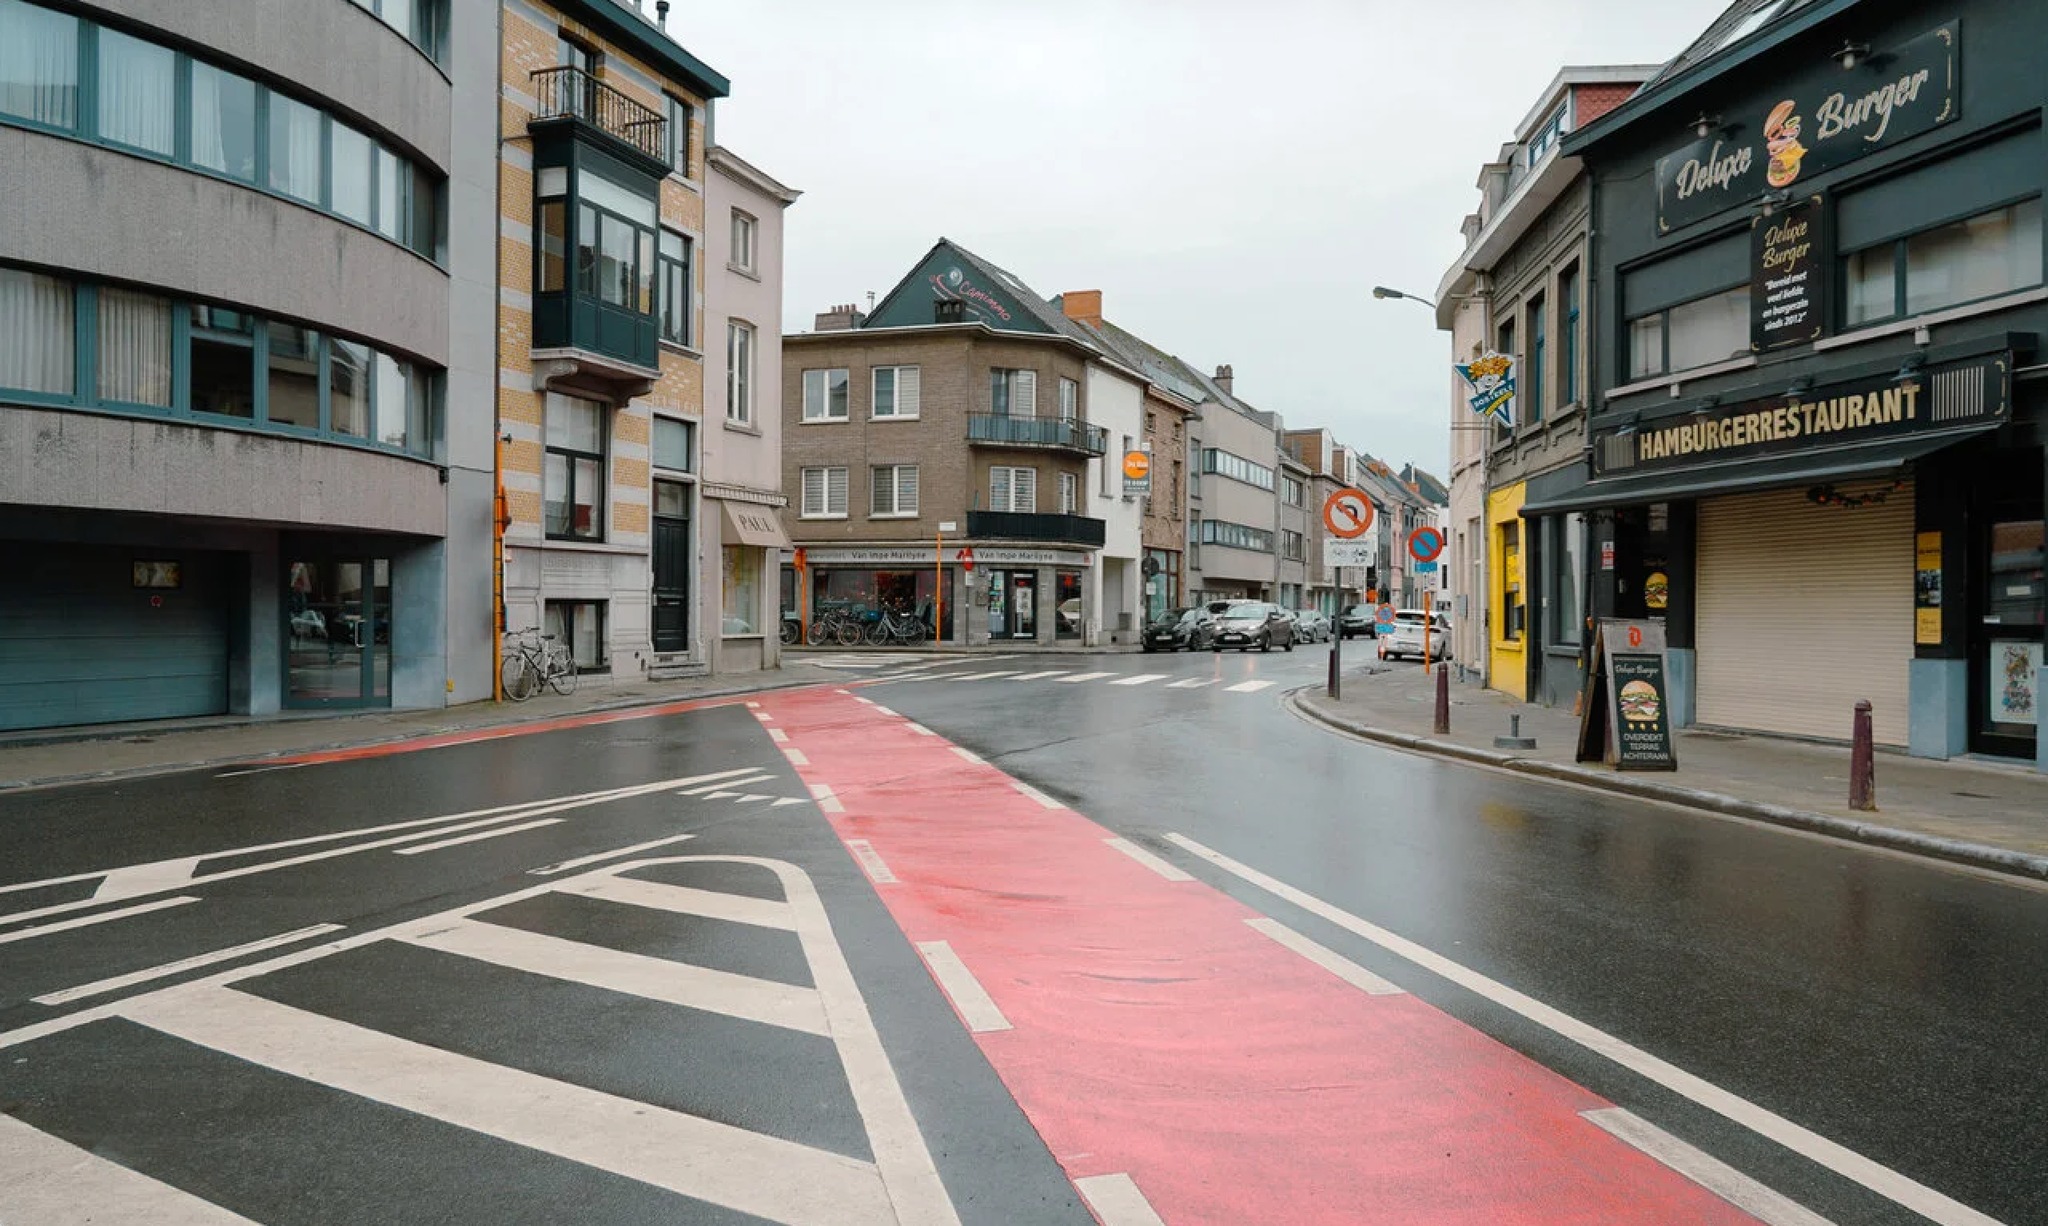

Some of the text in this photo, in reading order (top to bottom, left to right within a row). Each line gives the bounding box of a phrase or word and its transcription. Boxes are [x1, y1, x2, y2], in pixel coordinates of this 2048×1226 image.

[1676, 69, 1929, 199] Deluxe Burger
[1764, 217, 1808, 247] Deluxe
[1762, 243, 1811, 273] Burger
[1640, 384, 1921, 461] HAMBURGERRESTAURANT
[738, 514, 775, 533] PAUL
[851, 551, 867, 559] Van
[979, 551, 995, 559] Van
[1636, 664, 1659, 678] Burger
[1623, 733, 1664, 741] OVERDEKT
[1630, 742, 1660, 751] TERRAS
[1623, 752, 1669, 760] ACHTERAAN
